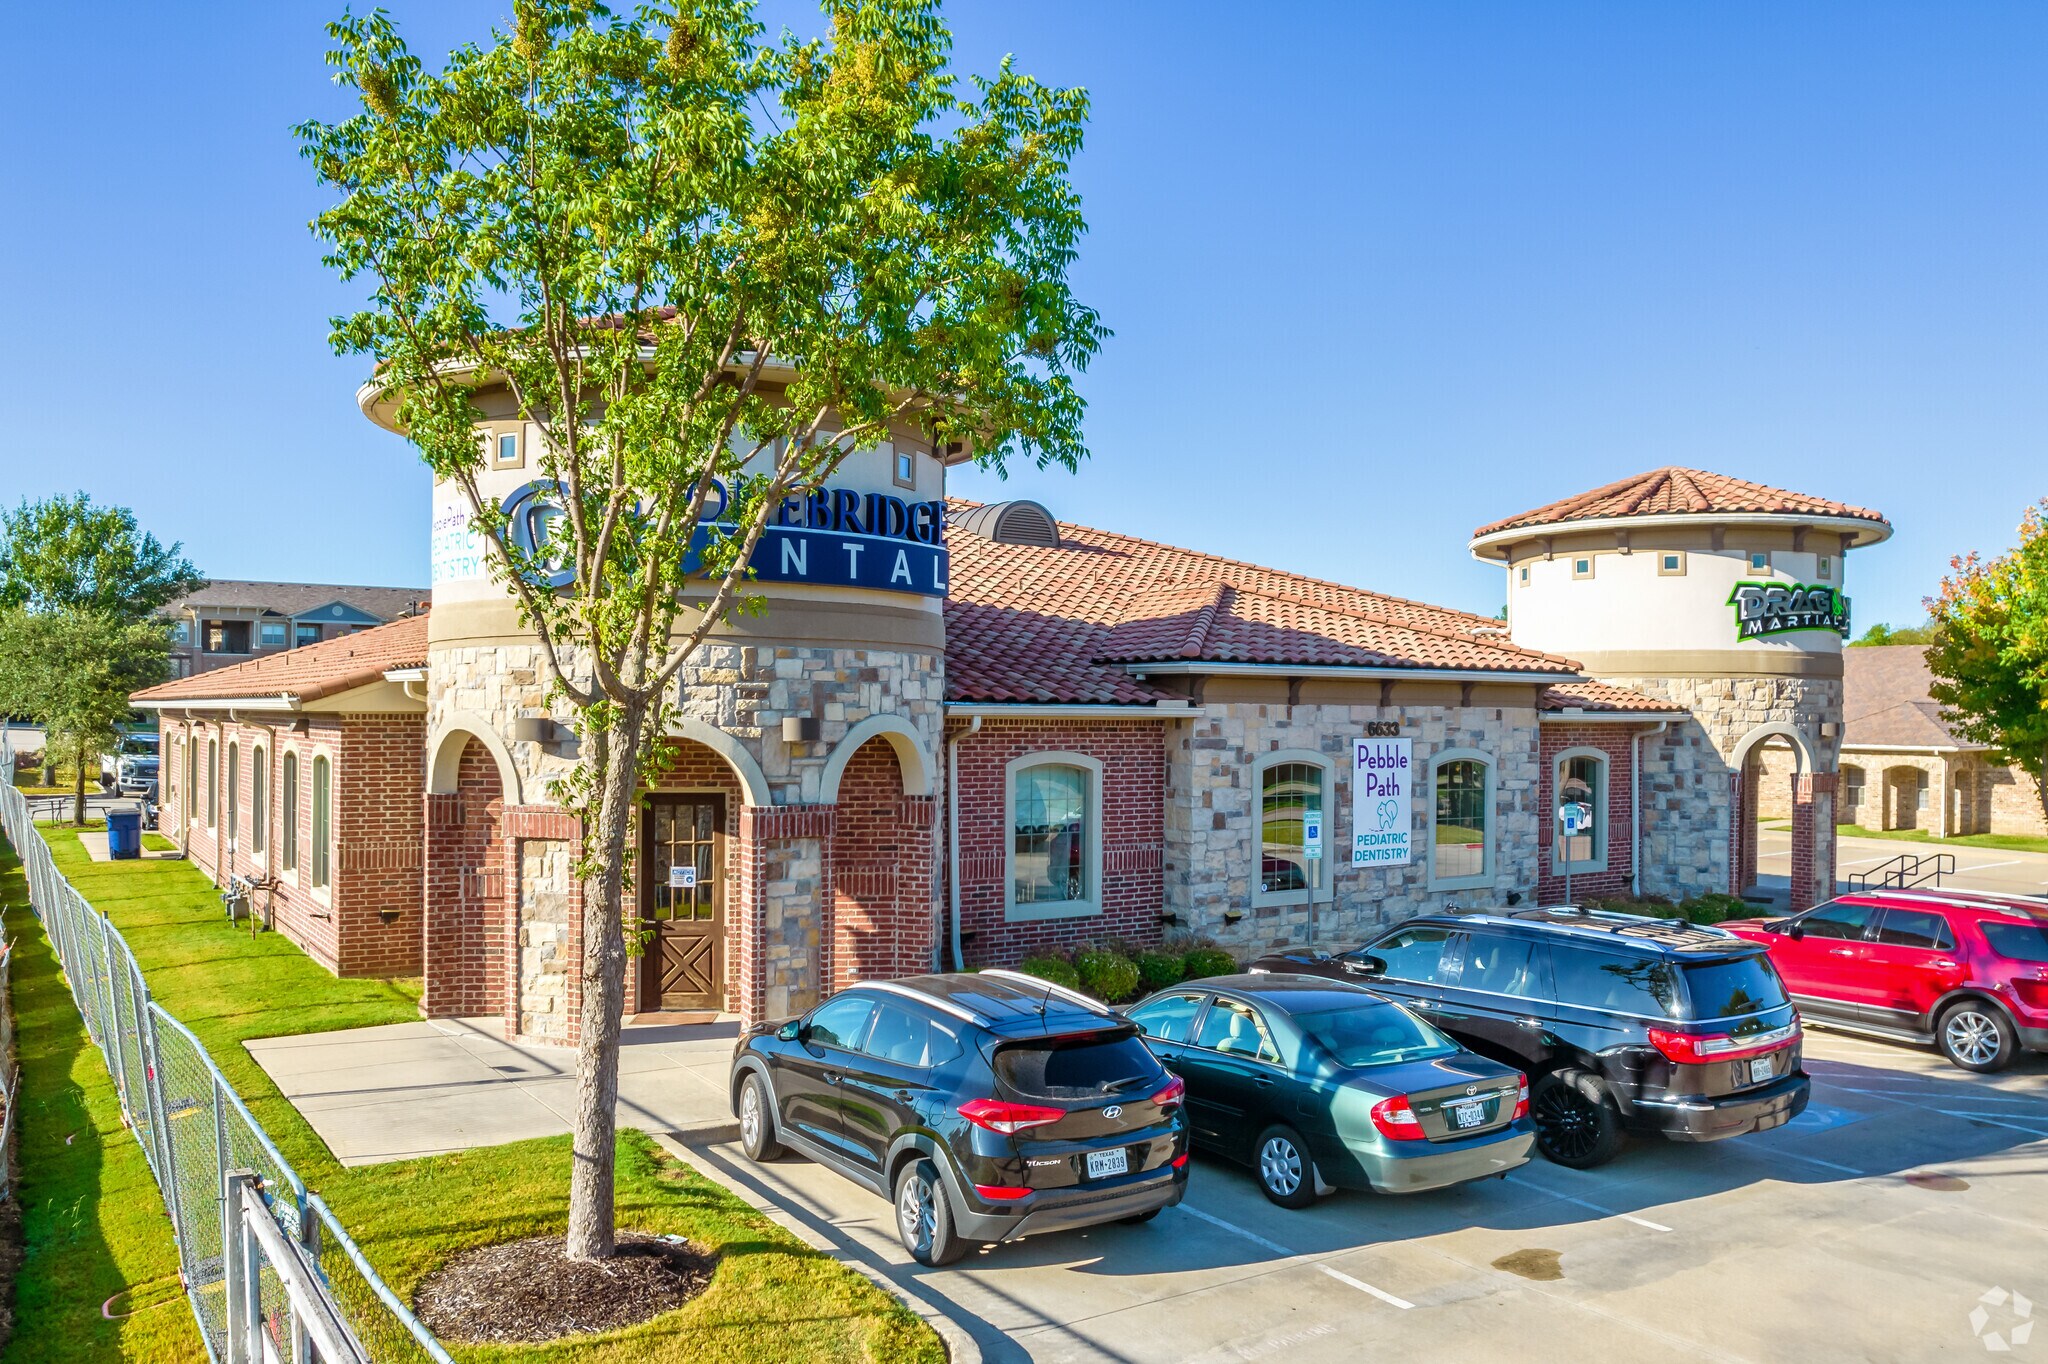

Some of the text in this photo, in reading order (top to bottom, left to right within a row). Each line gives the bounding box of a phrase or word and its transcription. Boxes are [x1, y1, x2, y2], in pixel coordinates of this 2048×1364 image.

[1367, 721, 1400, 737] 6633
[1357, 744, 1408, 770] Pebble
[1366, 772, 1400, 798] Path
[1357, 832, 1408, 847] PEDIATRIC
[1354, 847, 1409, 862] DENTISTRY
[1099, 1150, 1115, 1158] TEXAS
[1026, 1159, 1062, 1168] TUCSON
